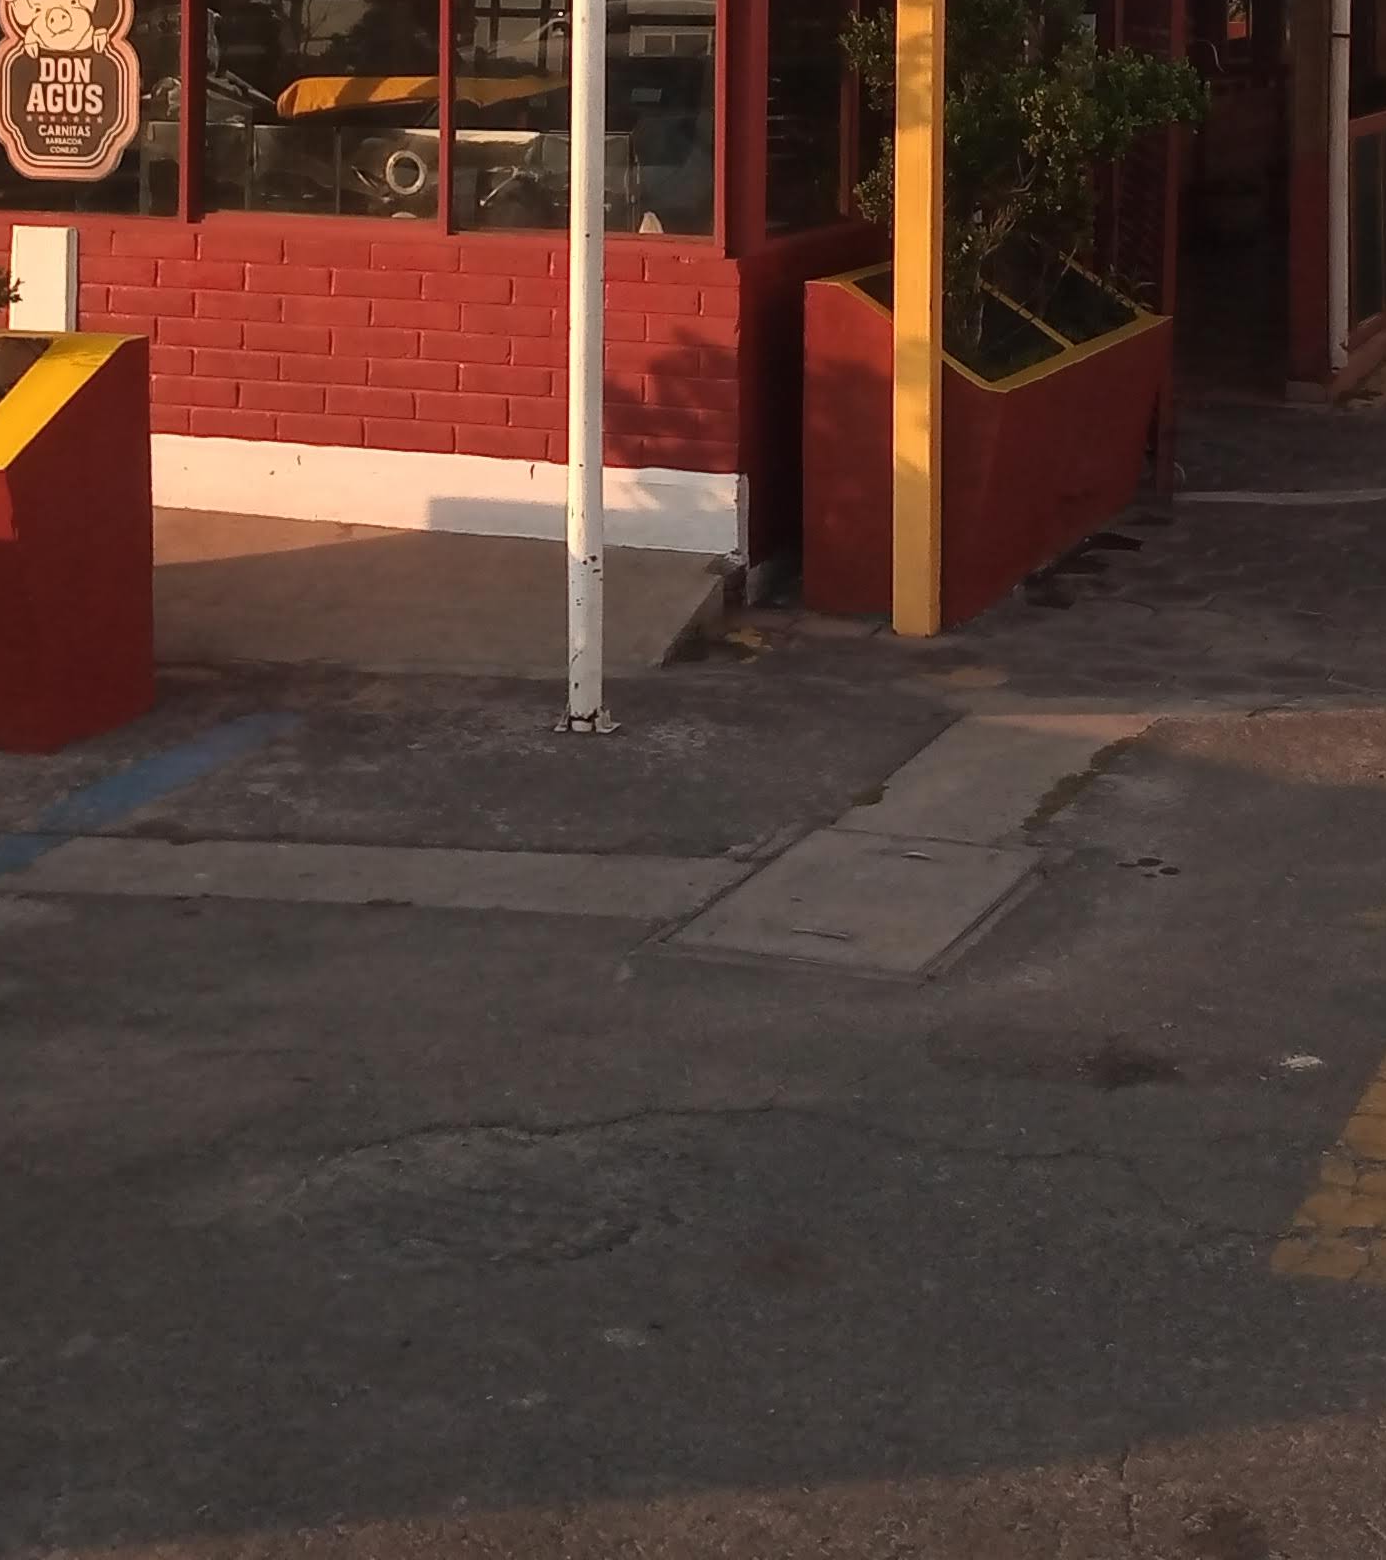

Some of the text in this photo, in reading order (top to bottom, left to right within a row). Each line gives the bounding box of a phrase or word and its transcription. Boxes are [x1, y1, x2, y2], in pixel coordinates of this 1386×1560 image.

[39, 57, 91, 83] DON
[26, 83, 103, 114] AGUS
[38, 124, 91, 137] CARNITAS
